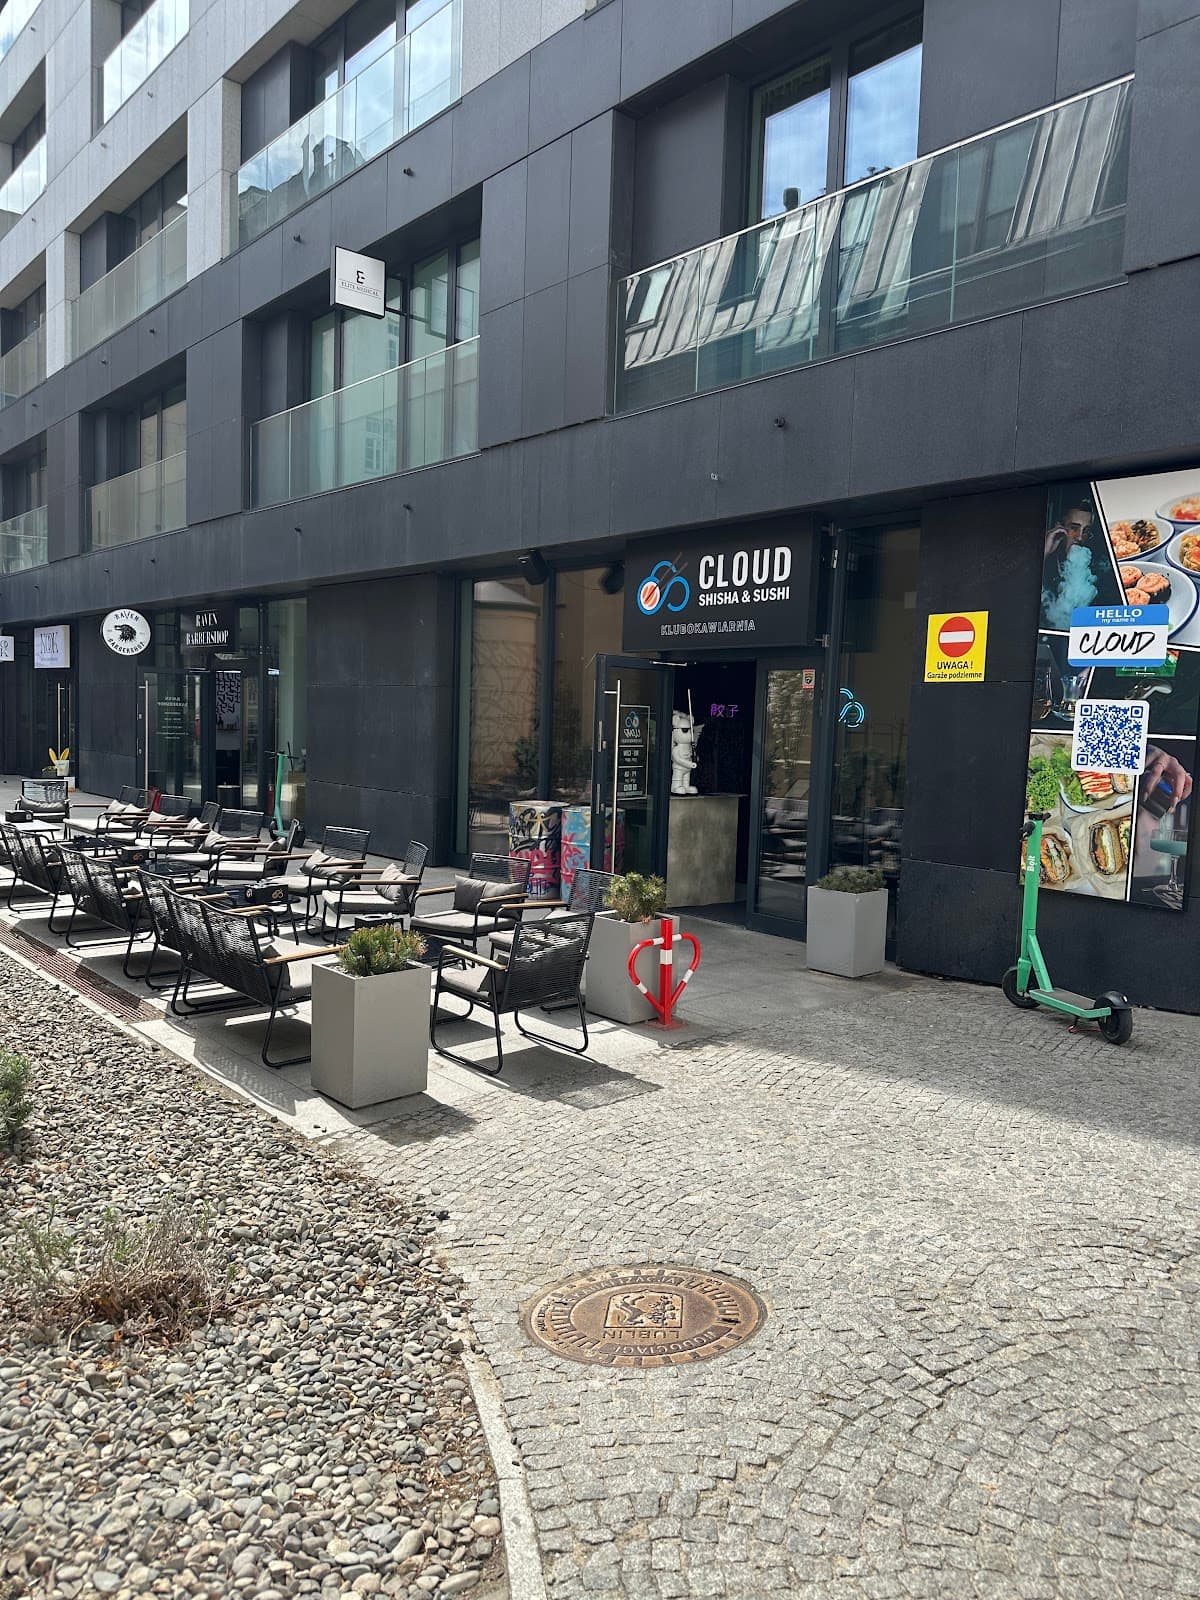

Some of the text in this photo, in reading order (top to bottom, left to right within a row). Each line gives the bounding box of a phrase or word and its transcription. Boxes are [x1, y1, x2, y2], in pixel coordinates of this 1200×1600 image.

[341, 281, 356, 290] ELITE
[699, 546, 792, 590] CLOUD
[698, 586, 790, 607] SHISHA & SUSHI
[195, 612, 218, 628] RAVEN
[1095, 608, 1142, 619] HELLO
[660, 619, 756, 636] KLUBOKAWIARNIA
[186, 629, 229, 646] BARBERSHOP
[1079, 630, 1156, 656] CLOUD
[936, 660, 969, 670] UWAGA
[927, 671, 983, 680] Garaże podziemne
[1027, 855, 1036, 872] Bolt
[602, 1330, 679, 1339] LUBLIN
